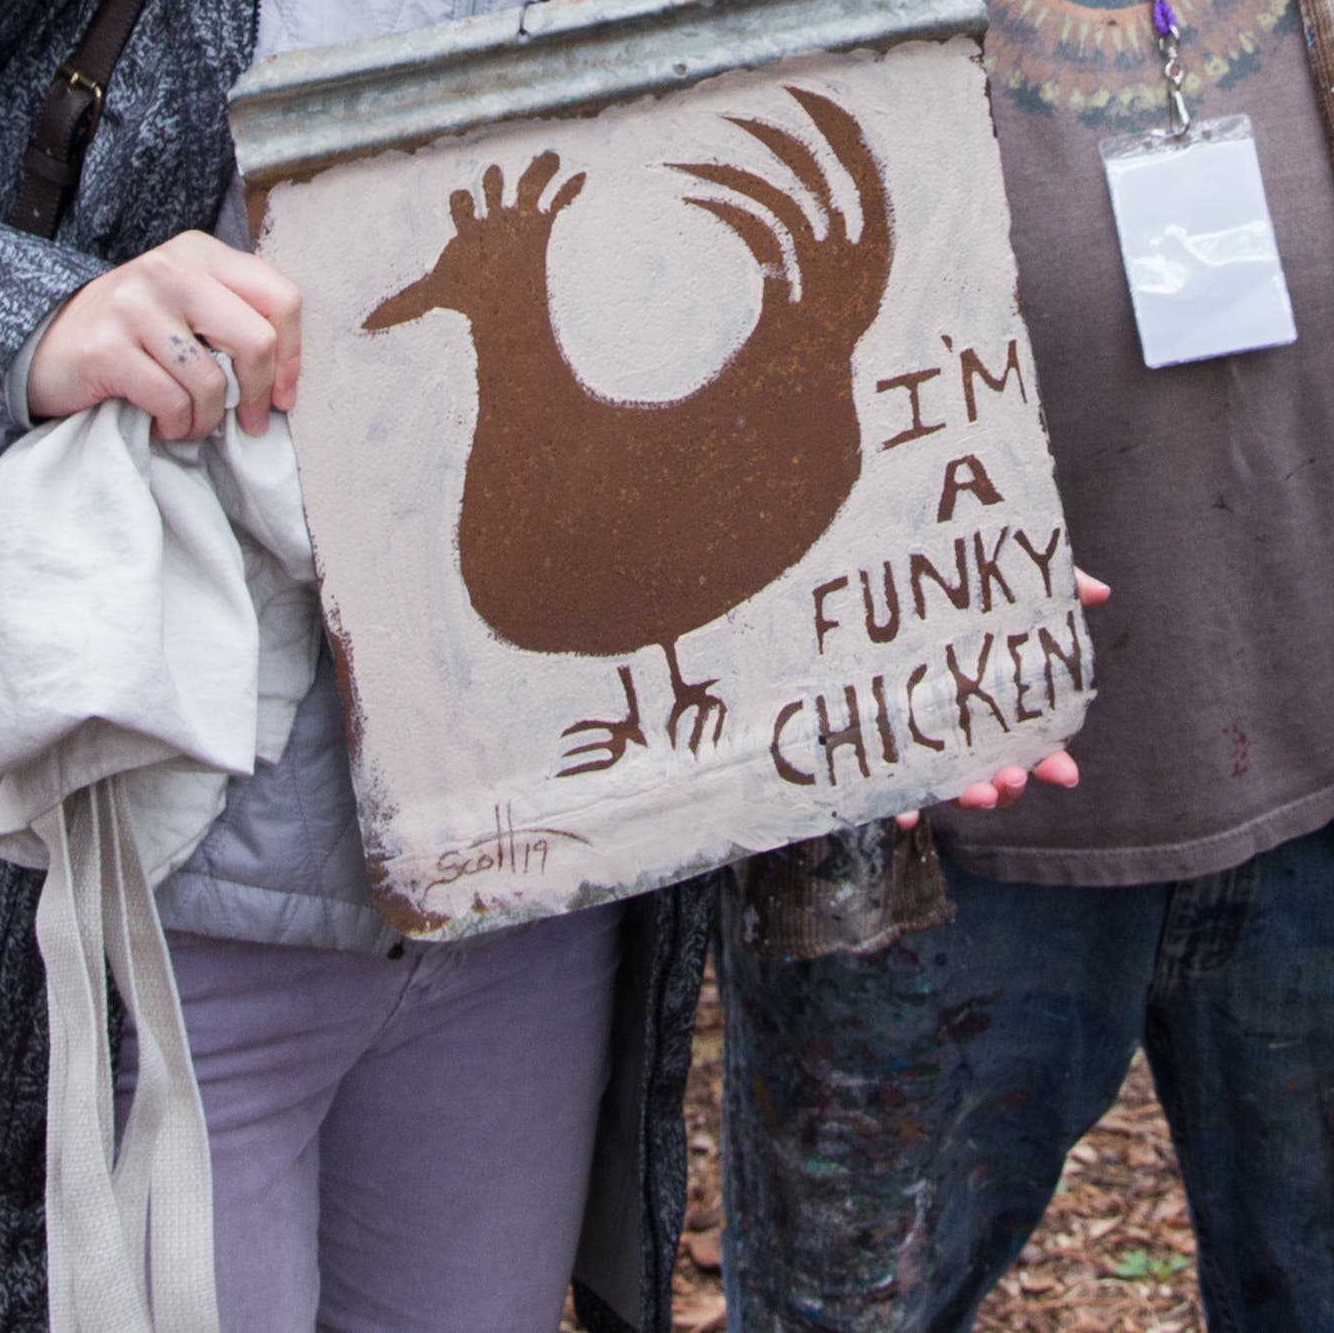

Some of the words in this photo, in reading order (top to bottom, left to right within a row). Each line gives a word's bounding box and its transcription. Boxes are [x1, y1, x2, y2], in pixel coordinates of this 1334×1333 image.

[876, 335, 1028, 451] I'M
[937, 454, 1005, 523] A
[812, 526, 1061, 655] FUNKY
[769, 609, 1084, 786] CHICKEN
